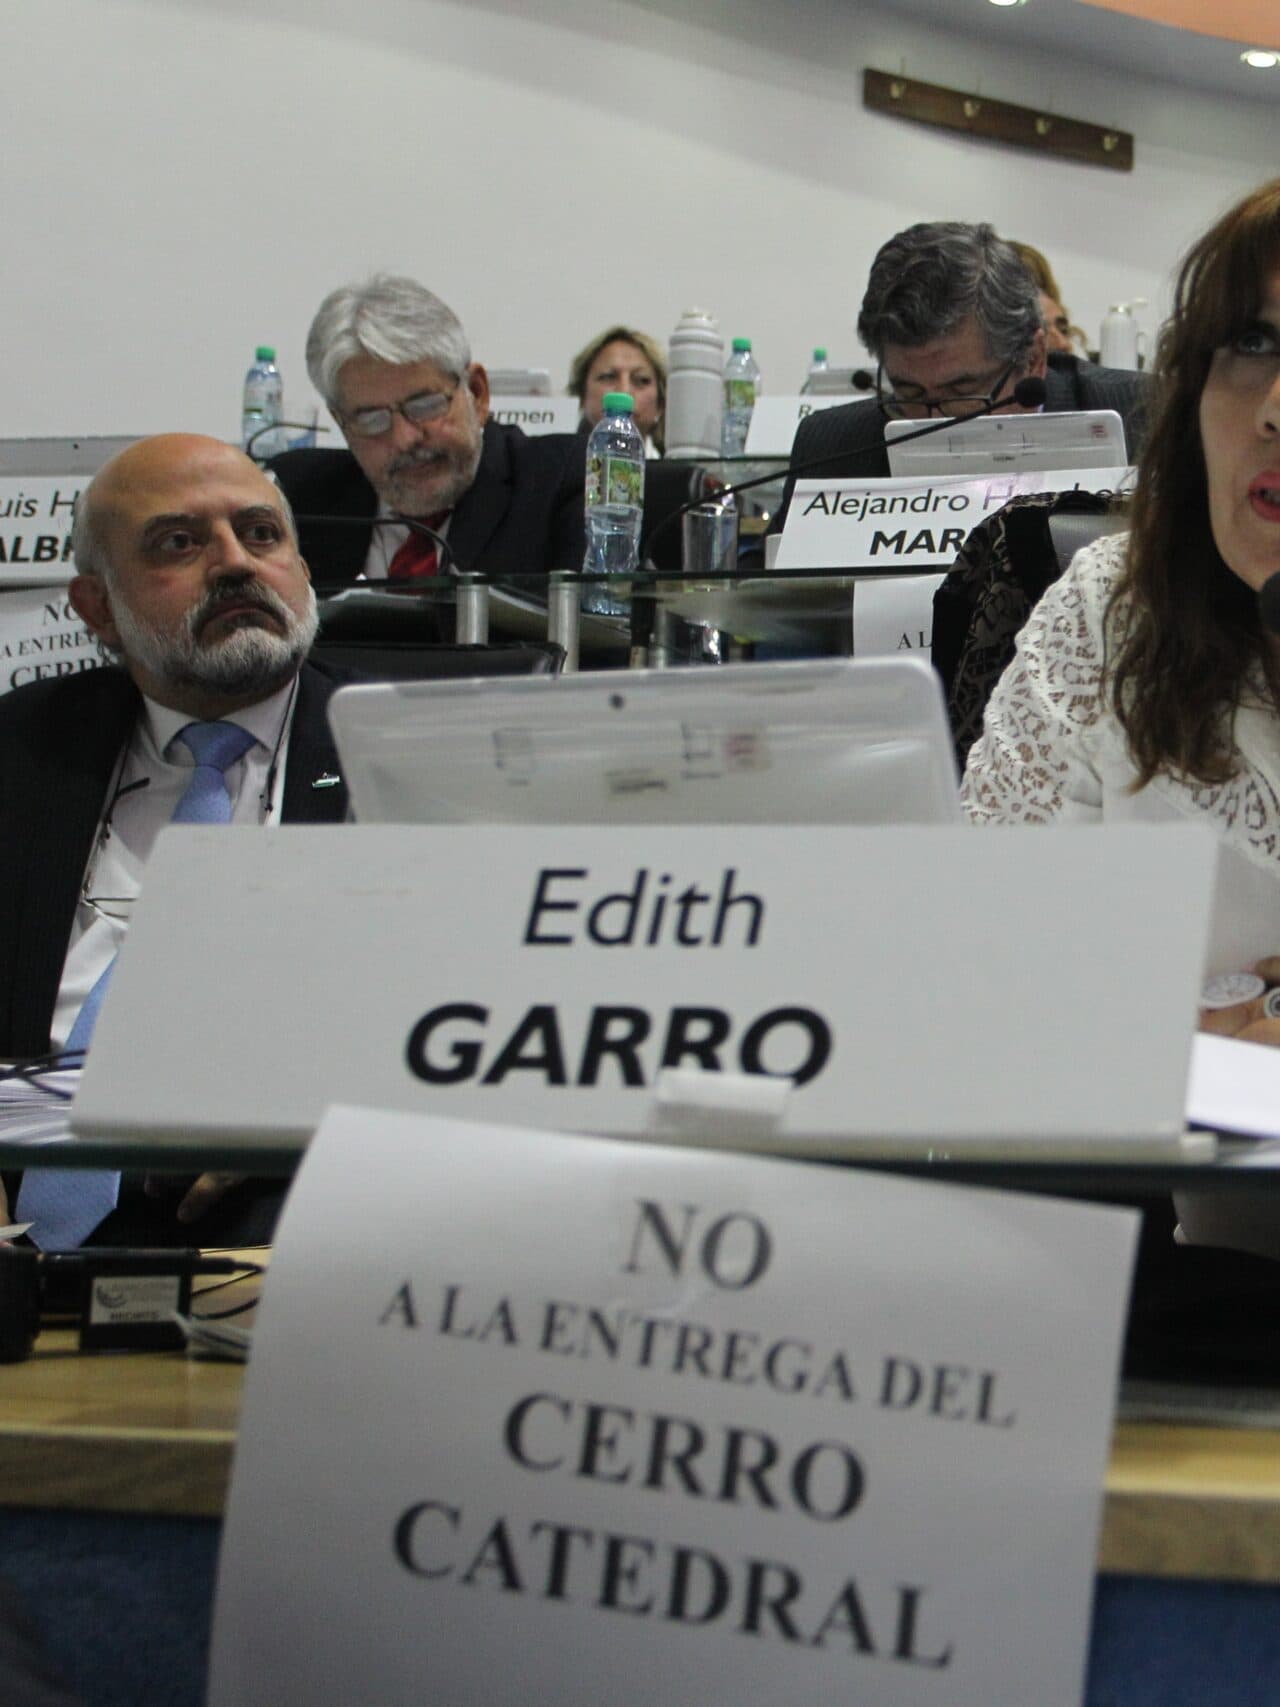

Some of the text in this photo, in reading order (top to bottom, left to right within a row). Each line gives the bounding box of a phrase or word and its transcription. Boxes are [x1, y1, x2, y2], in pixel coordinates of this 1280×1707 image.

[802, 487, 970, 522] Alejandro
[868, 527, 966, 557] MAR
[10, 657, 97, 690] CERR
[19, 631, 97, 656] ENTRE
[521, 867, 766, 949] Edith
[404, 1002, 834, 1089] GARRO
[622, 1199, 774, 1293] NO
[378, 1279, 1018, 1430] A LA ENTREGA DEL
[503, 1392, 867, 1523] CERRO
[392, 1500, 956, 1670] CATEDRAL
